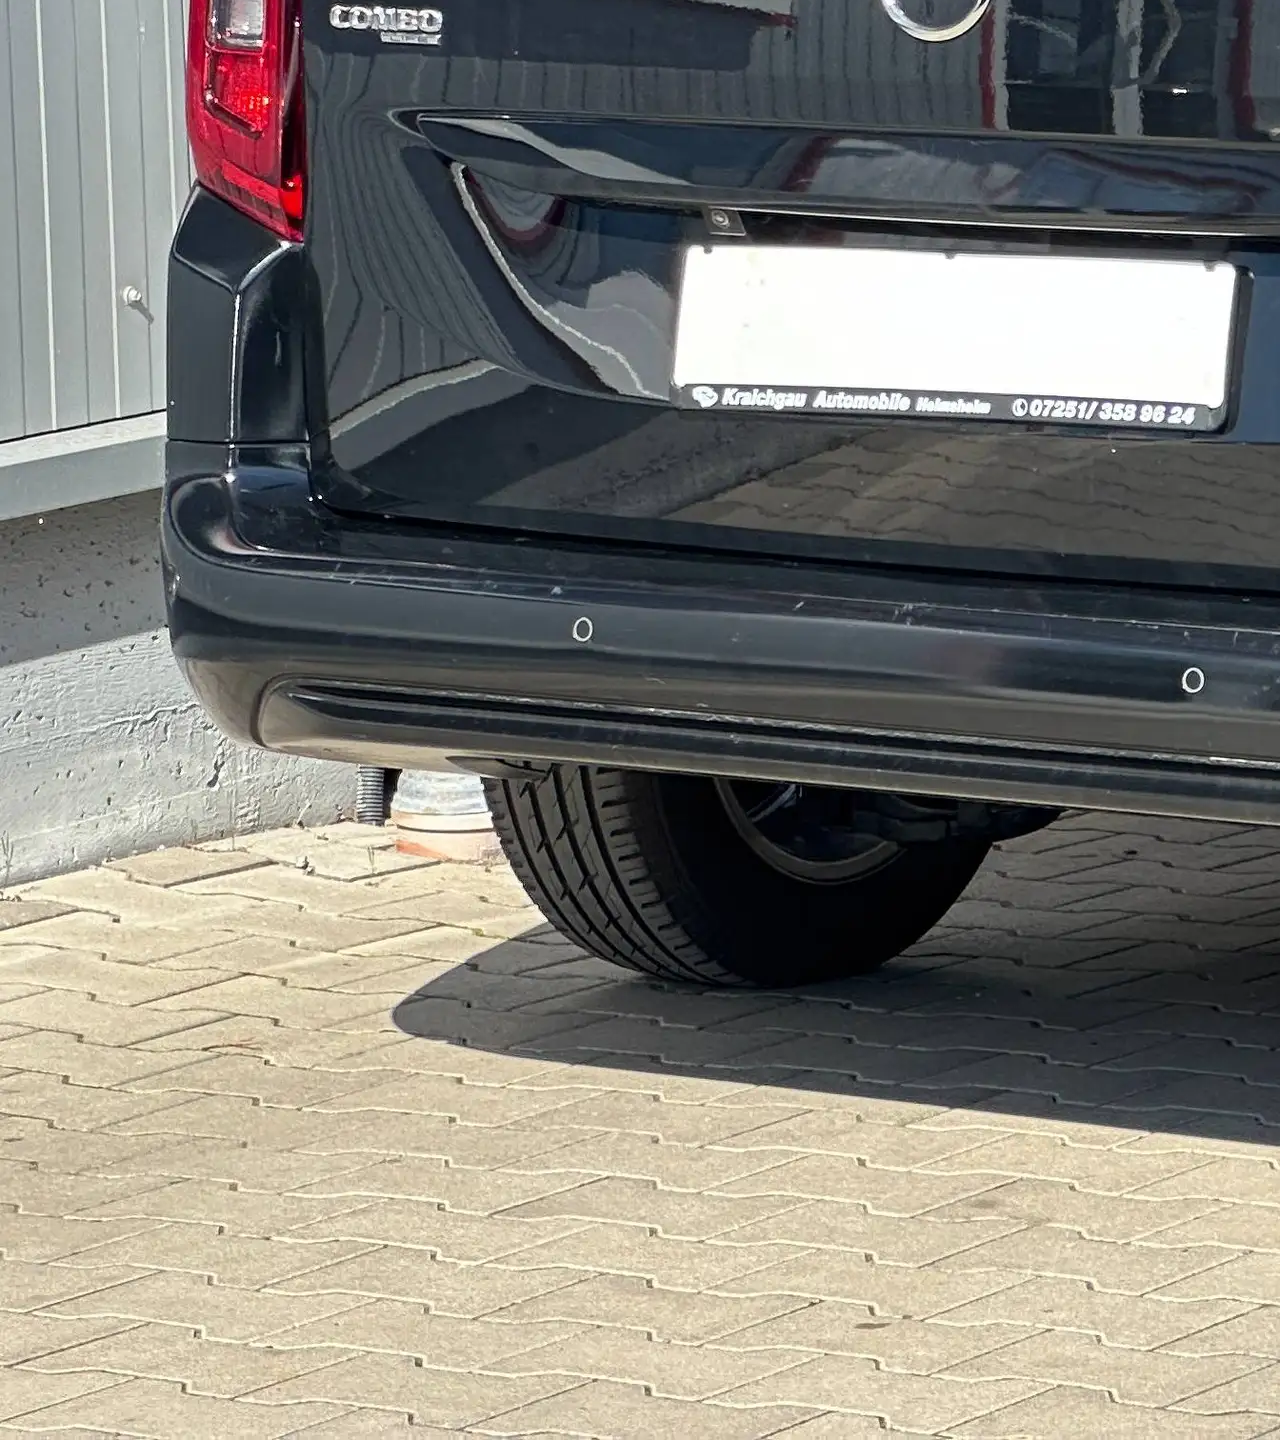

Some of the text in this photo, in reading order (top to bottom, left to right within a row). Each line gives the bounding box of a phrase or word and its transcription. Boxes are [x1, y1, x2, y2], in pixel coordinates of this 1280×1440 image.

[329, 5, 442, 33] COMBO
[721, 388, 807, 411] Kraichgau
[812, 390, 911, 412] Automobile
[1167, 406, 1197, 425] 24
